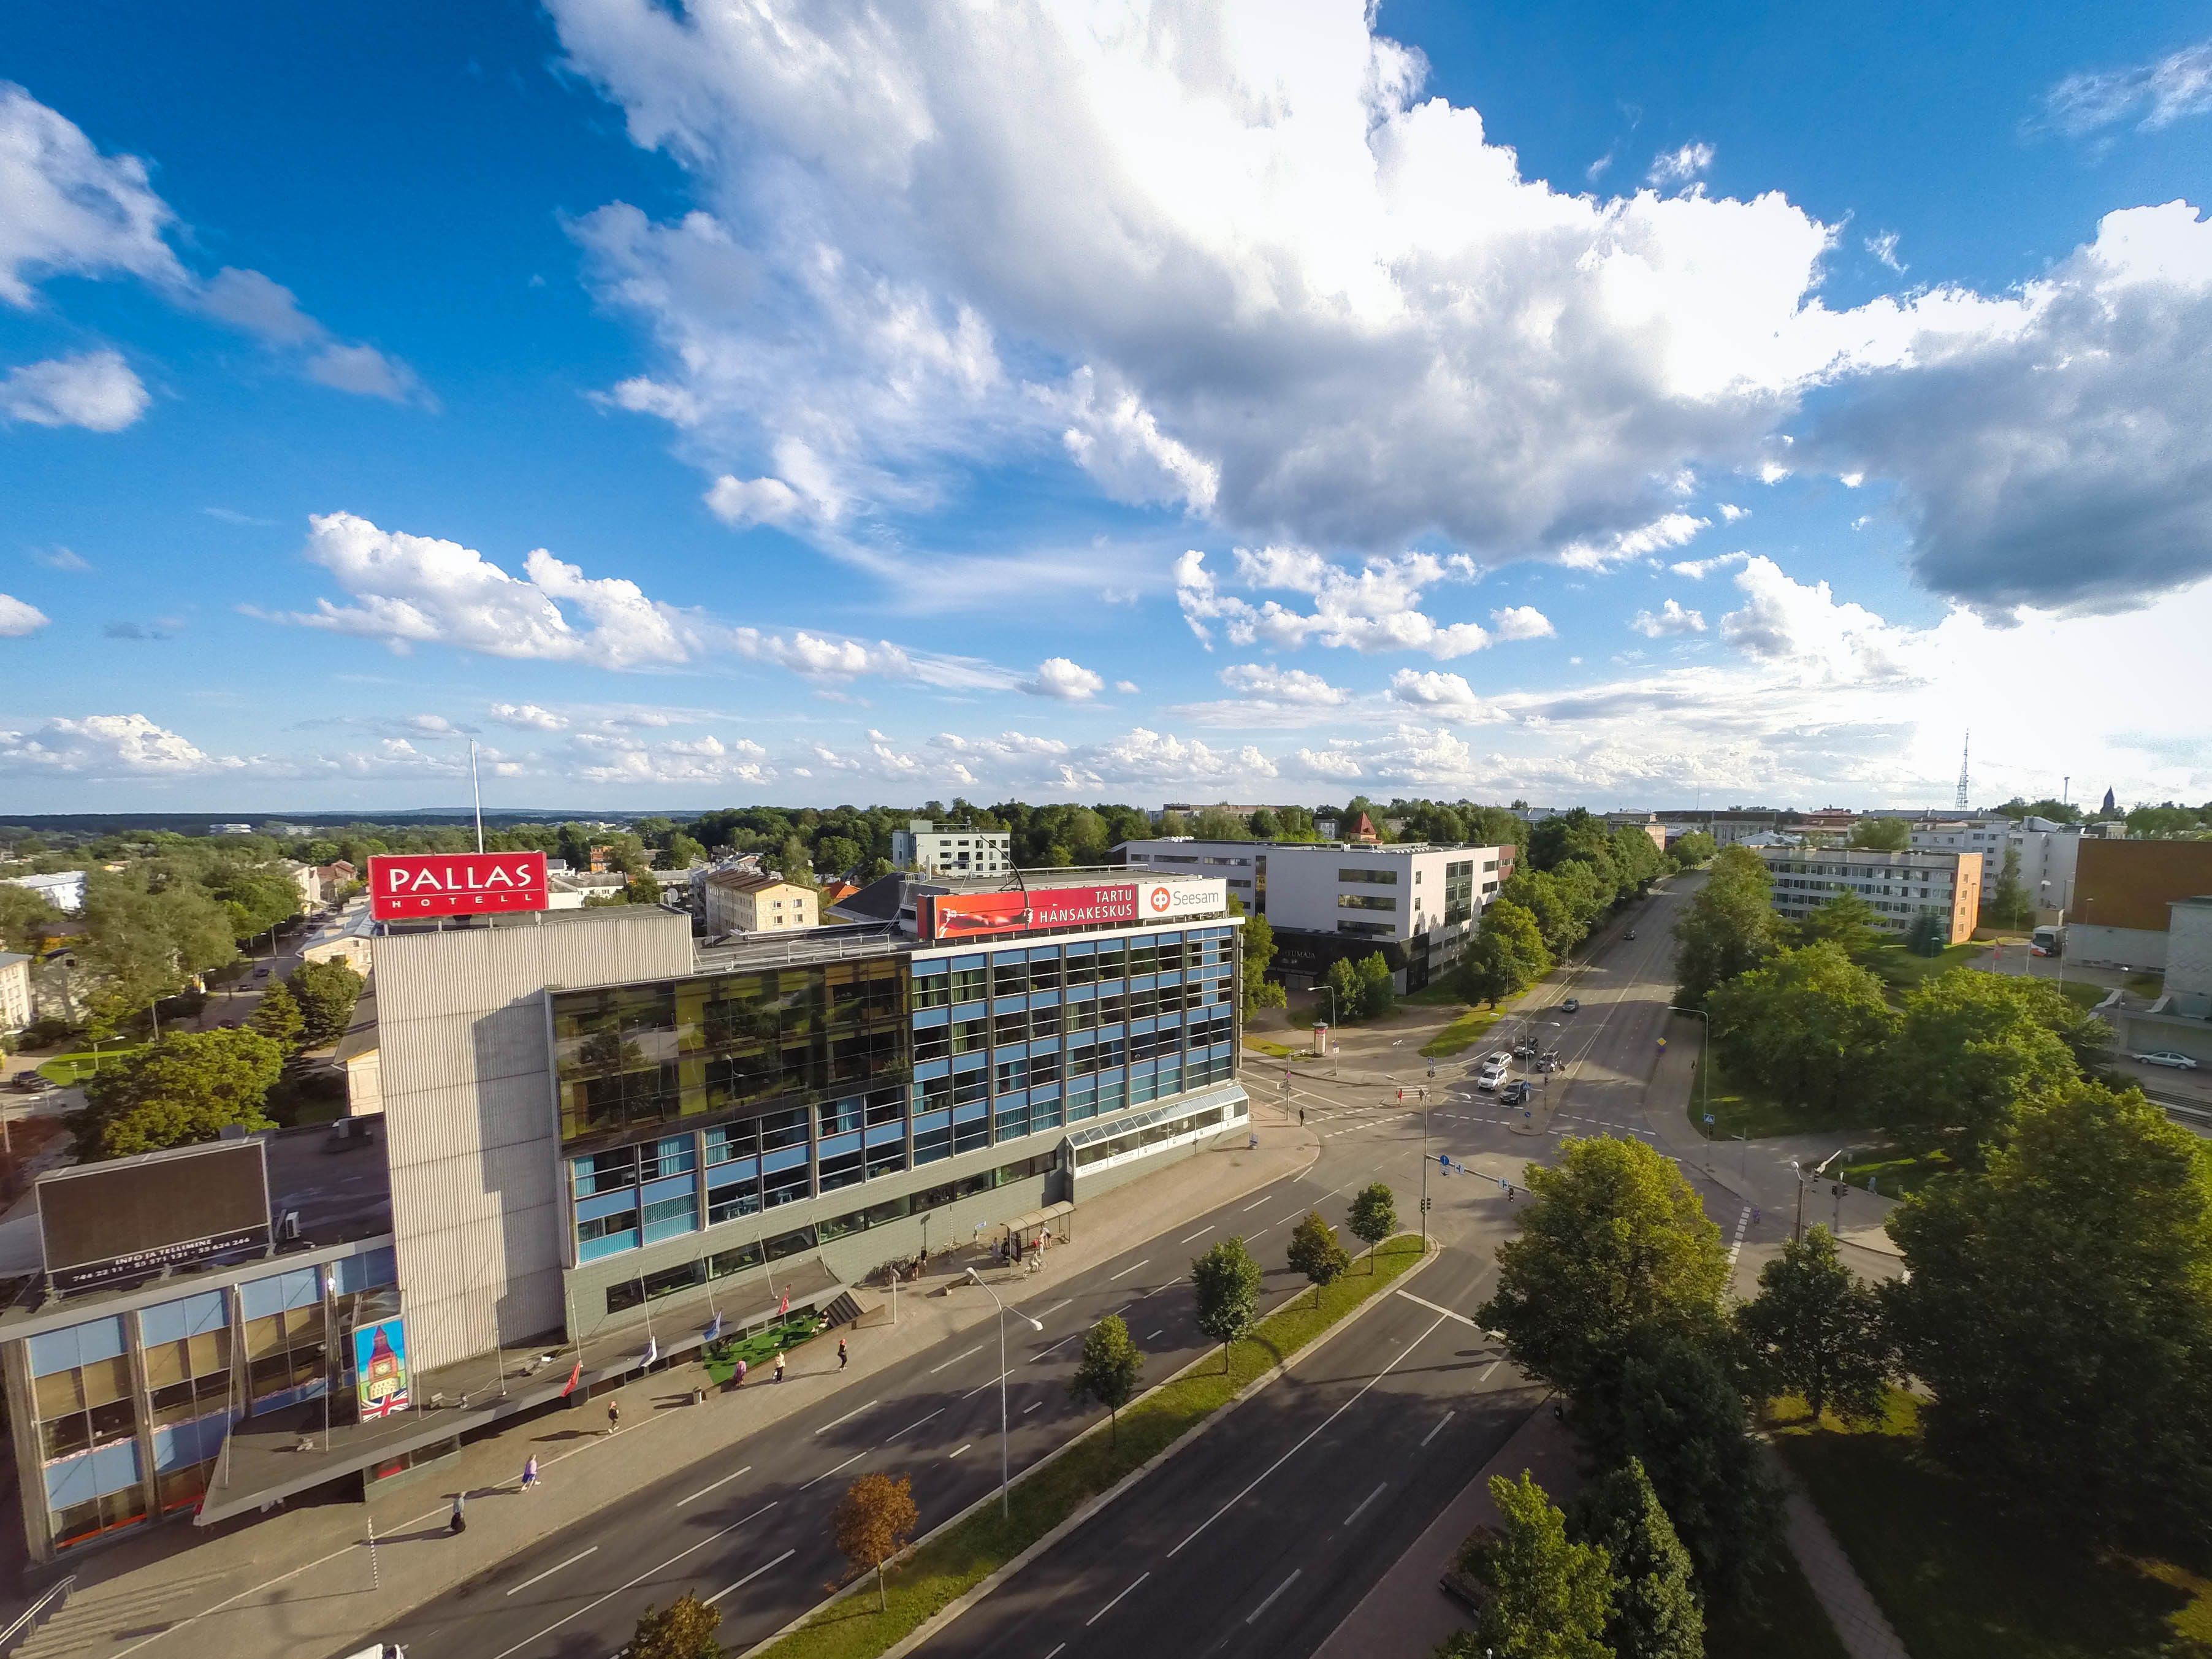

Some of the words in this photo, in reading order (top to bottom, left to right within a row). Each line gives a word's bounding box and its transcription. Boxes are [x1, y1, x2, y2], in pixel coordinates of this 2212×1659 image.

[389, 864, 532, 892] PALLAS
[392, 893, 532, 908] HOTELL
[1095, 890, 1132, 903] TARTU
[1173, 891, 1219, 906] Seesam
[1040, 904, 1132, 923] HANSAKESKUS
[115, 1254, 143, 1265] INFO
[159, 1239, 212, 1256] TELLIMINE
